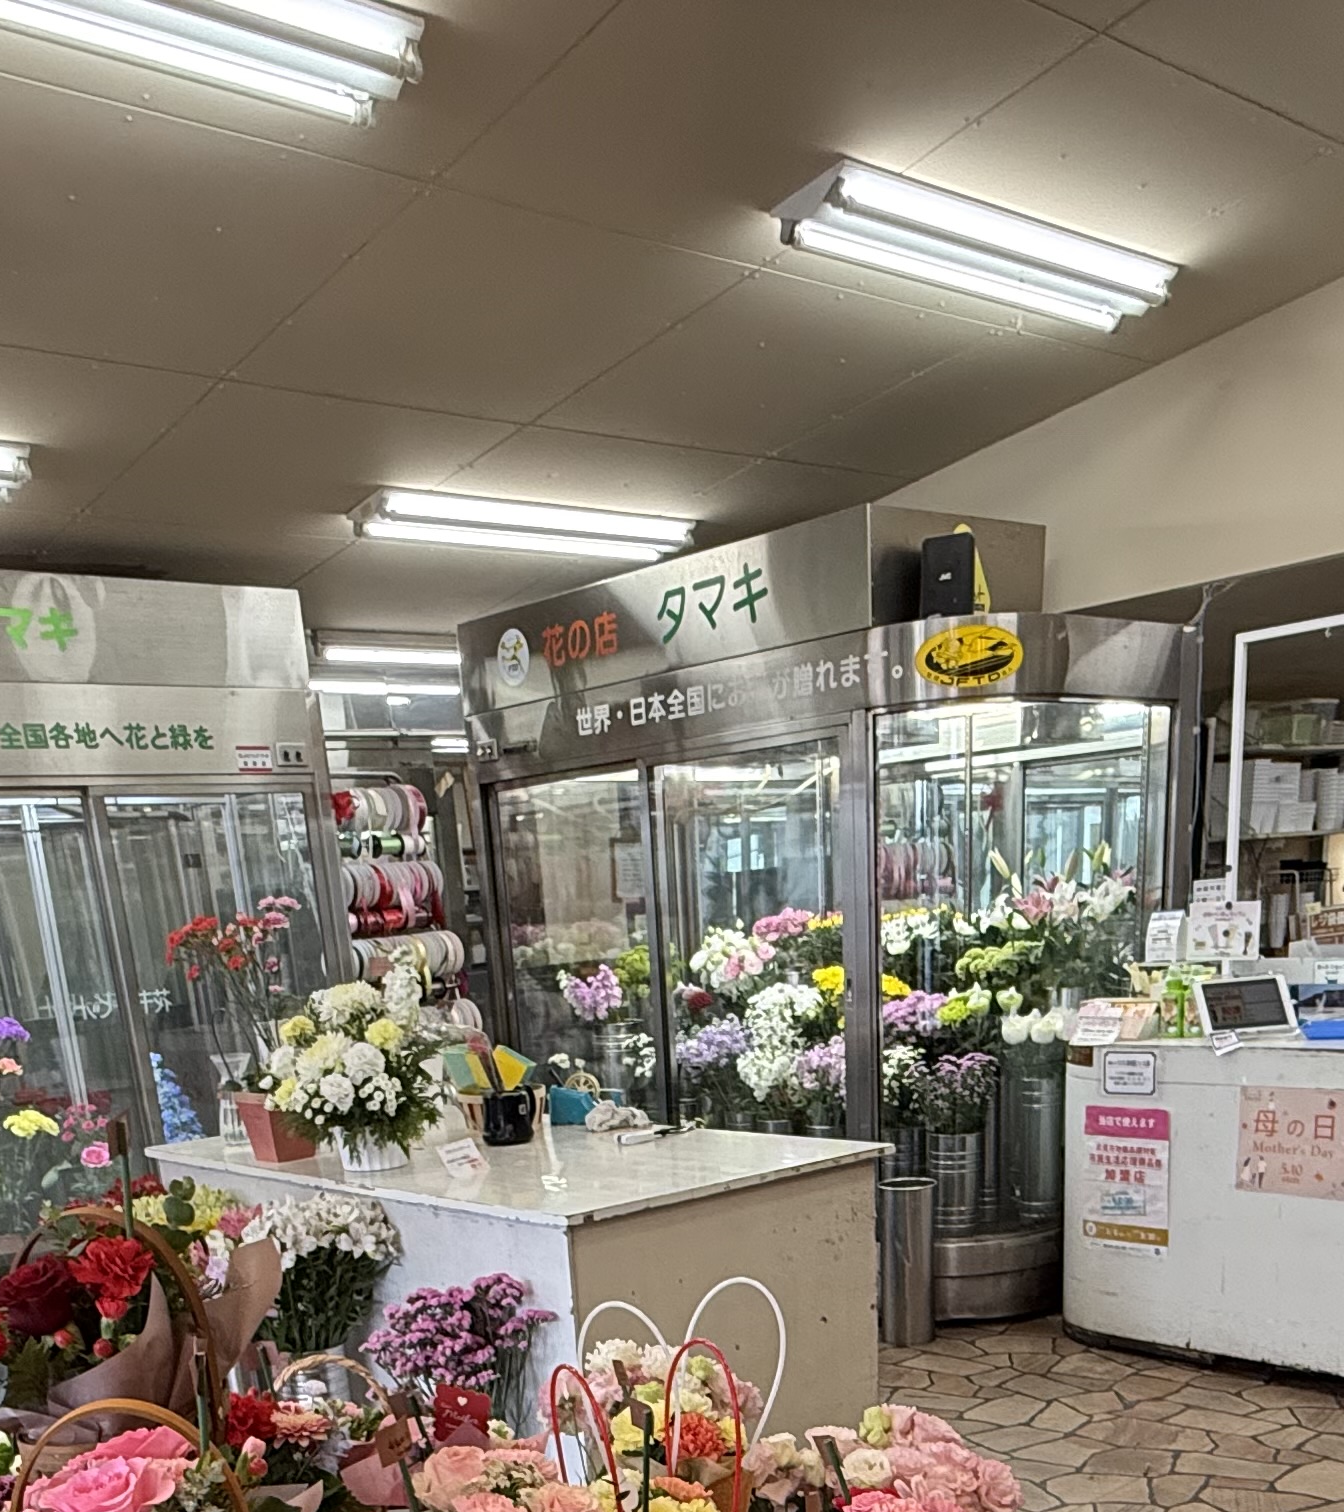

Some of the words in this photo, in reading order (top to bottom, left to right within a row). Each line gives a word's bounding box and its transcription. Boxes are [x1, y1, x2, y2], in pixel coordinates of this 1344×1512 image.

[542, 611, 618, 667] 花の店
[657, 562, 768, 645] タマキ
[940, 672, 1001, 686] JFTD
[1098, 1115, 1155, 1128] 当店で使えます
[1254, 1110, 1335, 1141] 母の日
[1252, 1140, 1305, 1158] Mother's
[1310, 1145, 1334, 1160] Day
